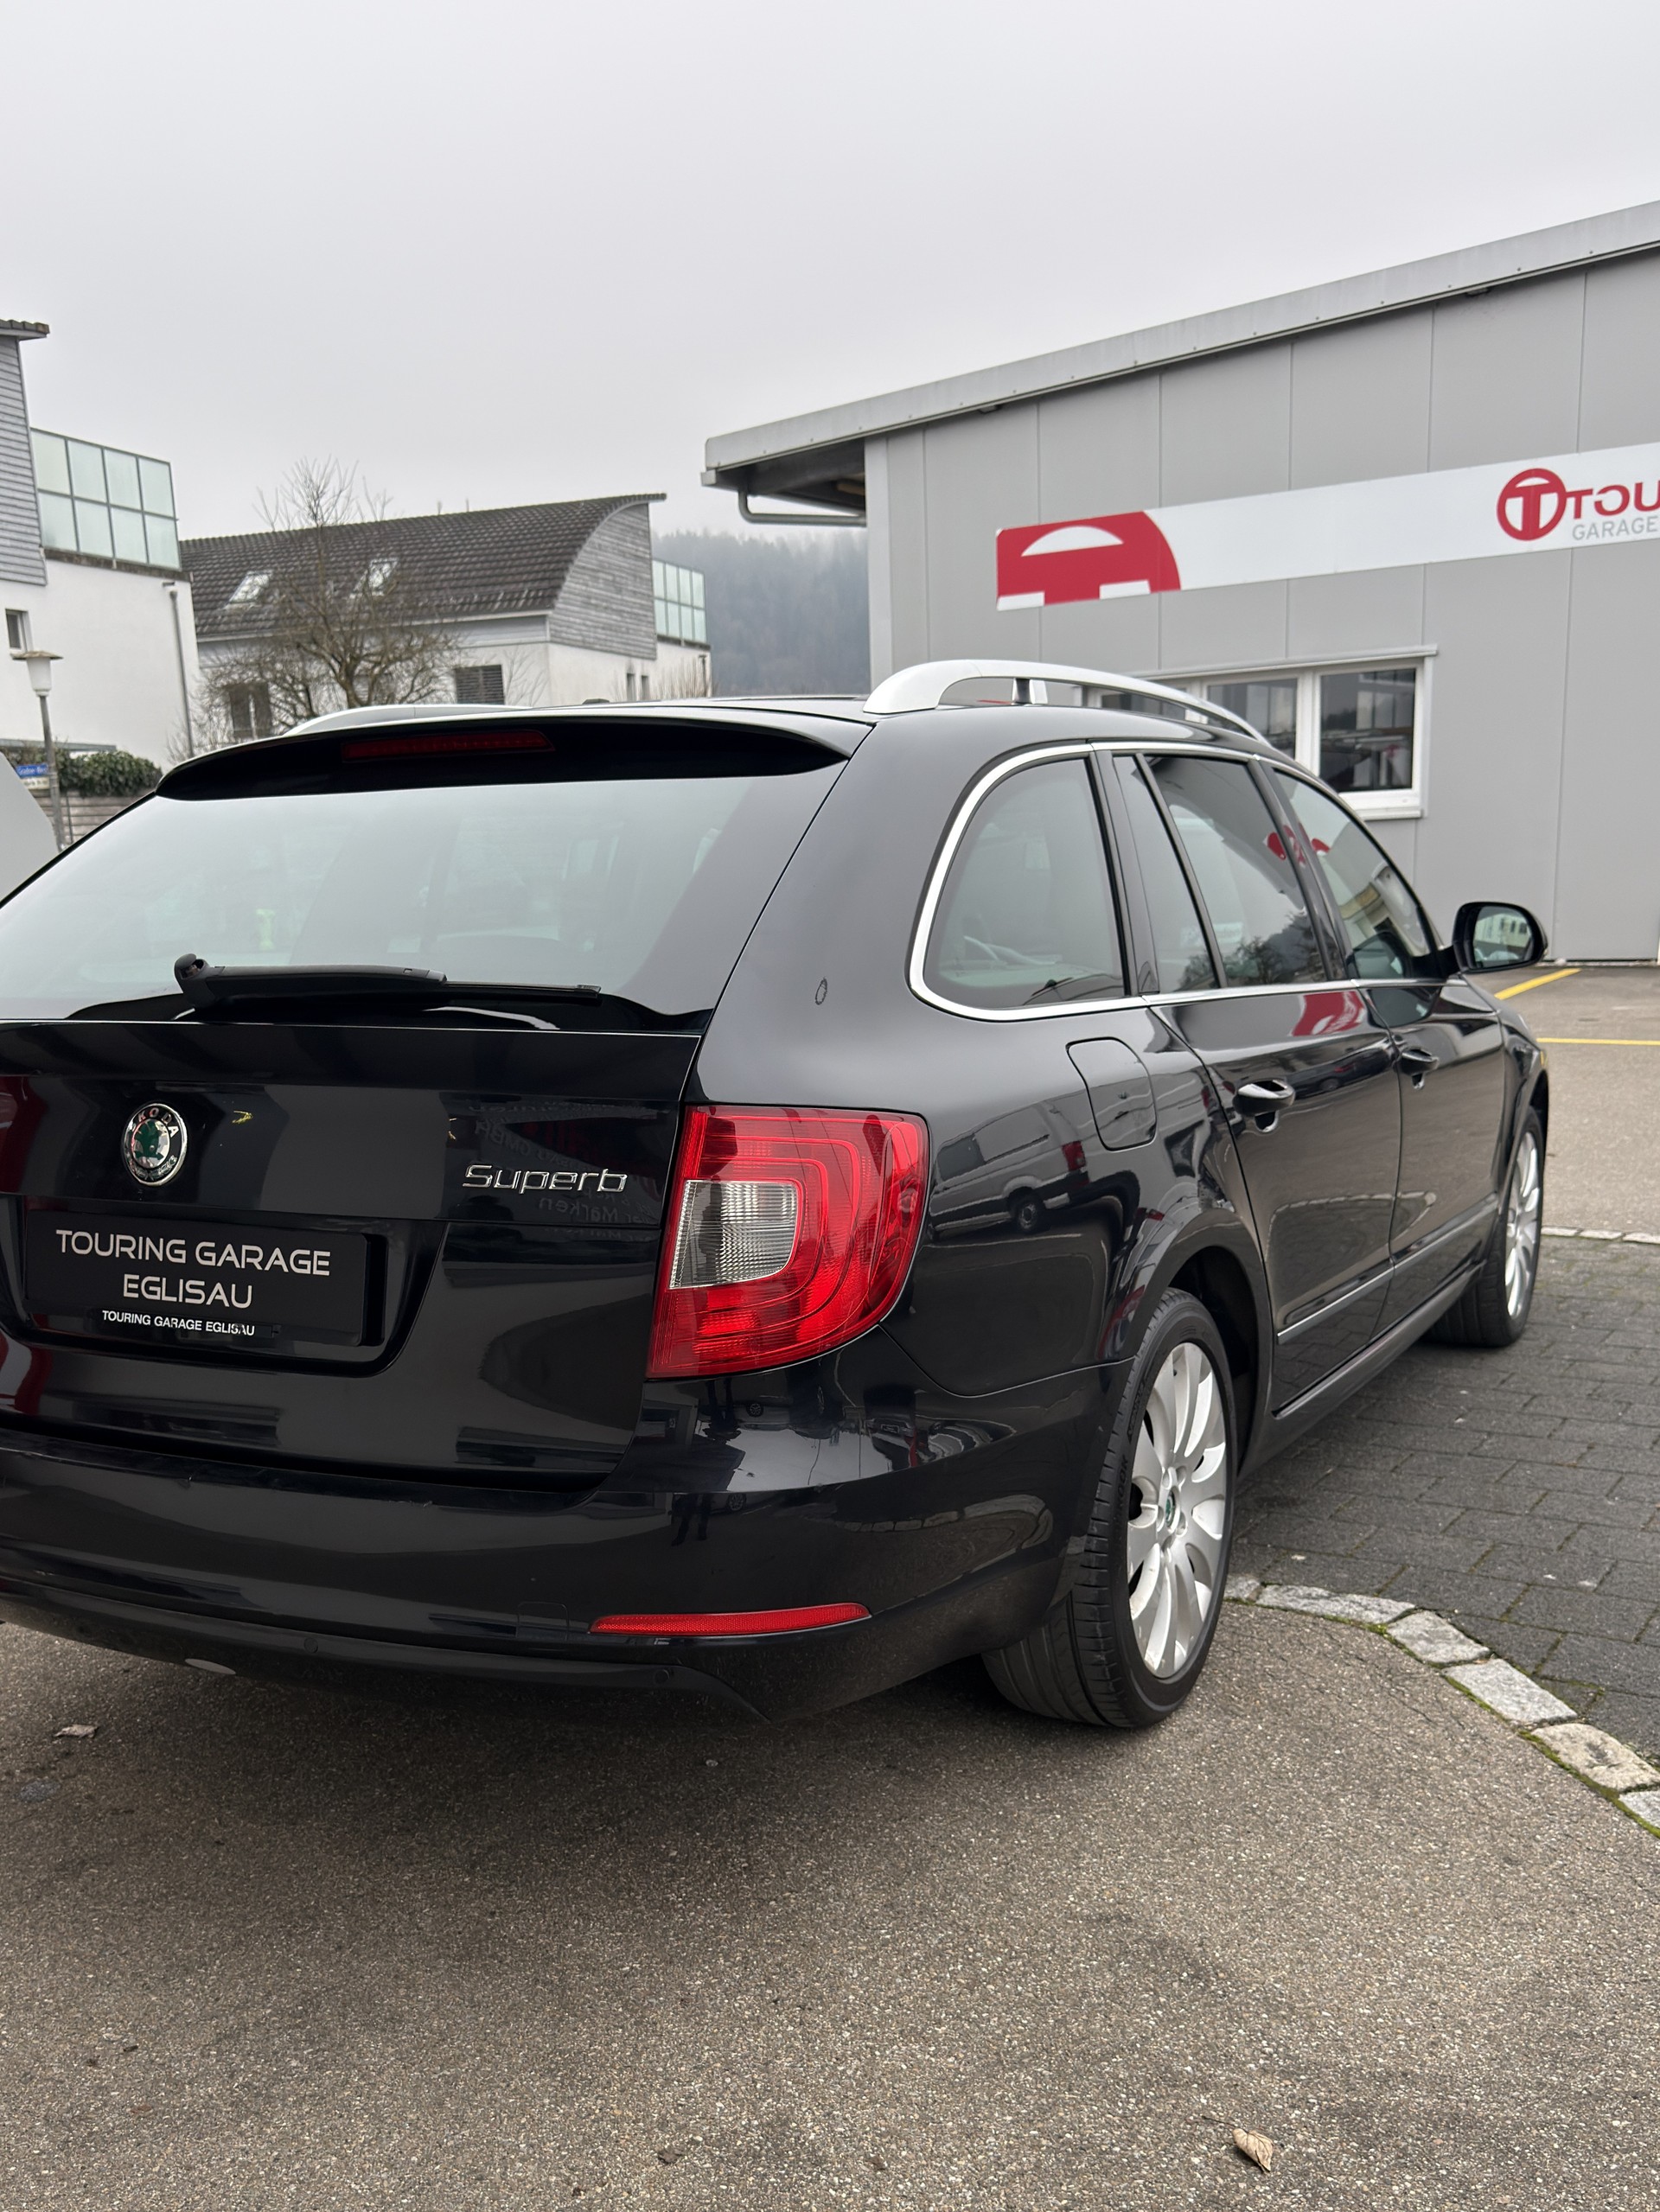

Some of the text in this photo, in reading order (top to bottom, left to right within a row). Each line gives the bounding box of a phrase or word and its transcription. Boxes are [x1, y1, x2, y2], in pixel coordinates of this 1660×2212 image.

[1572, 515, 1658, 541] GARAGE
[463, 1164, 628, 1195] Superb
[56, 1229, 331, 1276] TOURING GARAGE
[123, 1273, 253, 1309] EGLISAU
[102, 1310, 255, 1336] TOURING GARAGE EGLISAU
